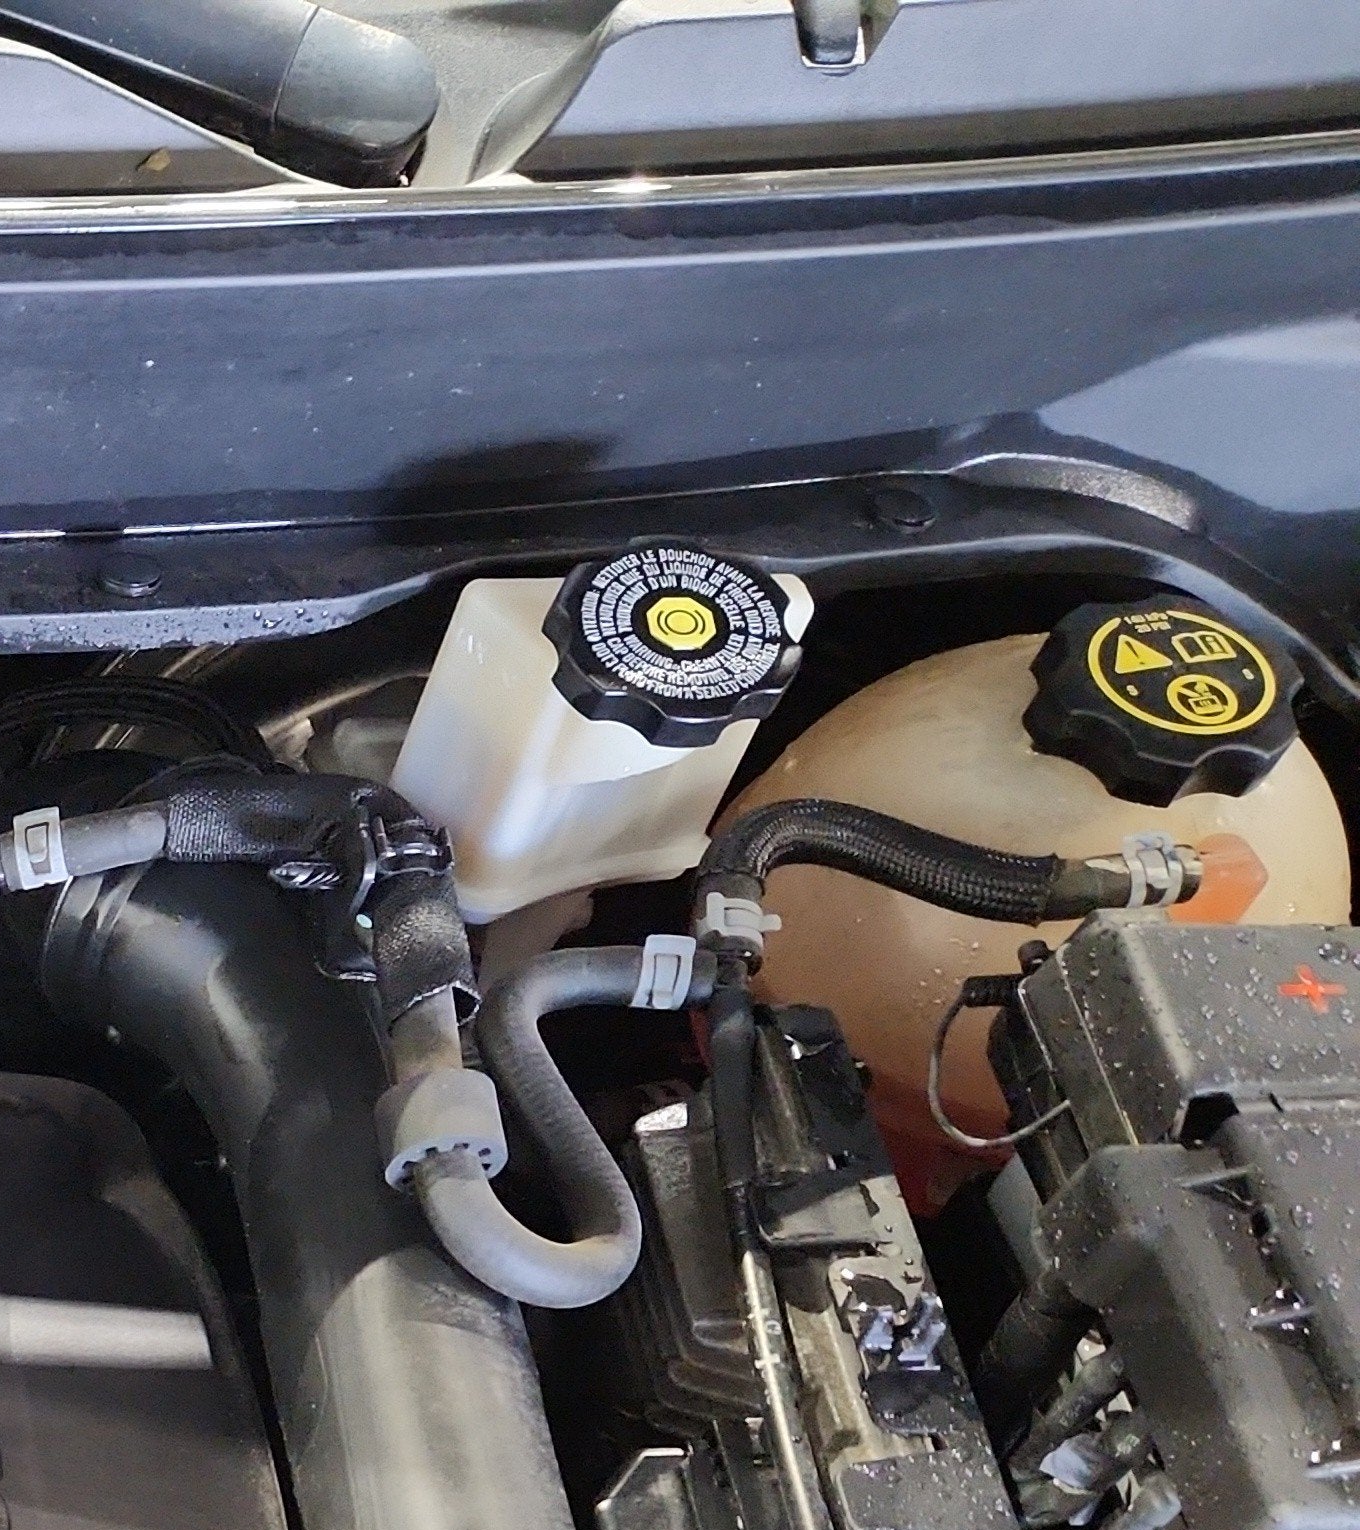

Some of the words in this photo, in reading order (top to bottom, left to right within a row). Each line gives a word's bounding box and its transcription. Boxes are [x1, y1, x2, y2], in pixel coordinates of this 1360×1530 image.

[591, 553, 641, 589] NETTOYER
[640, 549, 657, 563] LE
[658, 548, 716, 569] BOUCHON
[715, 562, 753, 589] AVANT
[746, 585, 765, 601] LA
[619, 567, 644, 586] QUE
[642, 563, 660, 577] DU
[662, 561, 708, 580] LIQUIDE
[708, 572, 727, 588] DE
[723, 582, 755, 610] FREIN
[647, 574, 678, 590] D'UN
[680, 574, 718, 598] BIDON
[607, 637, 629, 656] CAP
[621, 652, 665, 681] BEFORE
[724, 656, 751, 674] USE
[680, 656, 722, 673] CLEAN
[715, 633, 745, 667] FILLER
[645, 680, 683, 699] FROM
[682, 686, 694, 700] A
[693, 680, 740, 700] SEALED
